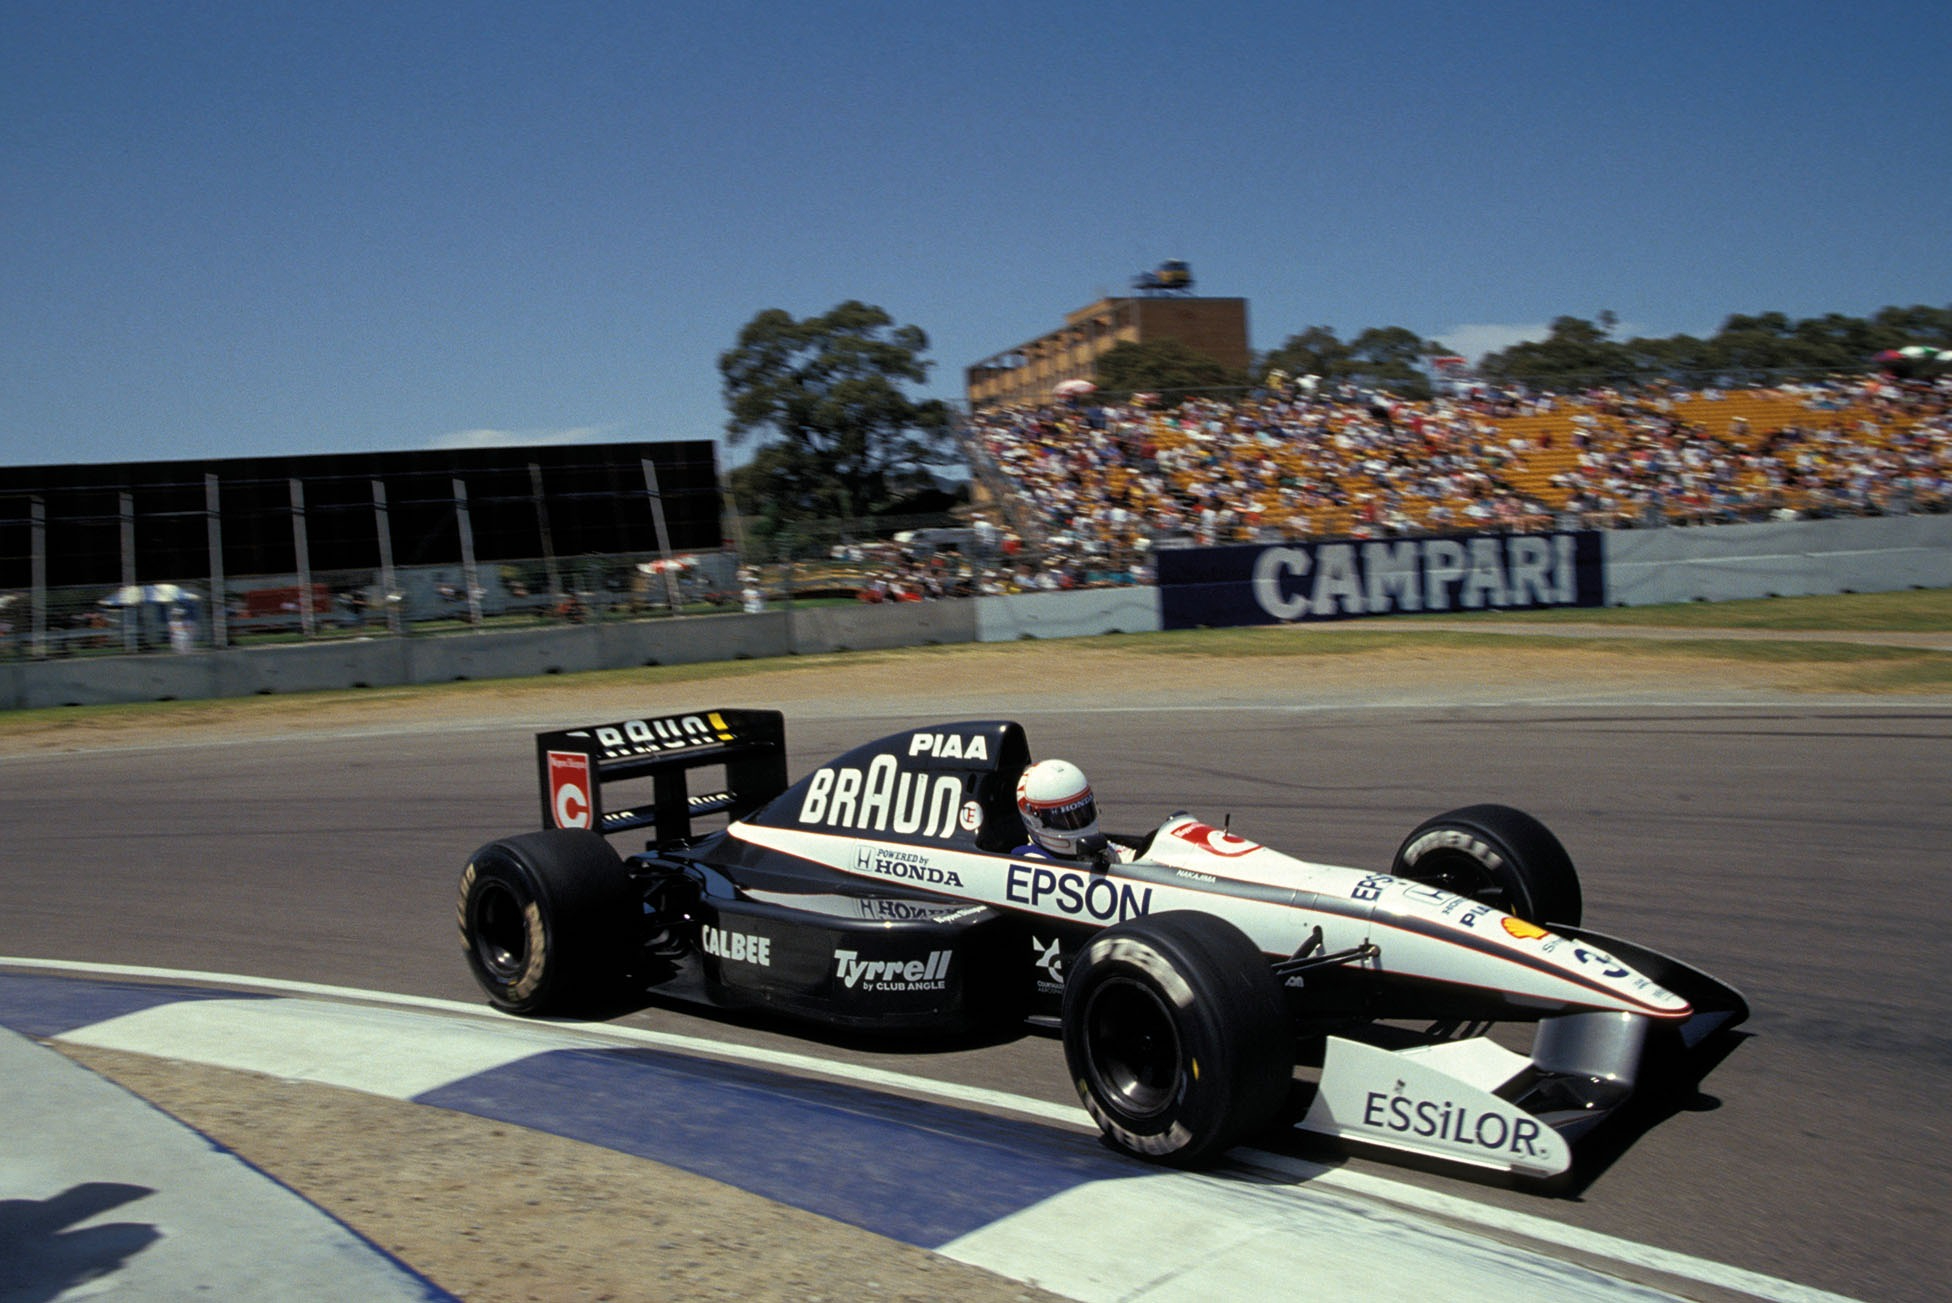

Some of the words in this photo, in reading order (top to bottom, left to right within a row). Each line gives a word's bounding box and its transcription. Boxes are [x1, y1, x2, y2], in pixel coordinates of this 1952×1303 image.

[1252, 535, 1577, 620] CAMPARI
[908, 733, 988, 760] PIAA
[798, 753, 963, 839] BRAUN
[874, 858, 964, 888] HONDA
[877, 848, 918, 863] POWERED
[919, 856, 930, 866] by
[1006, 864, 1152, 923] EPSON
[702, 924, 771, 967] CALBEE
[834, 949, 953, 988] Tyrrell
[863, 981, 874, 992] by
[876, 981, 906, 991] CLUB
[907, 980, 946, 991] ANGLE
